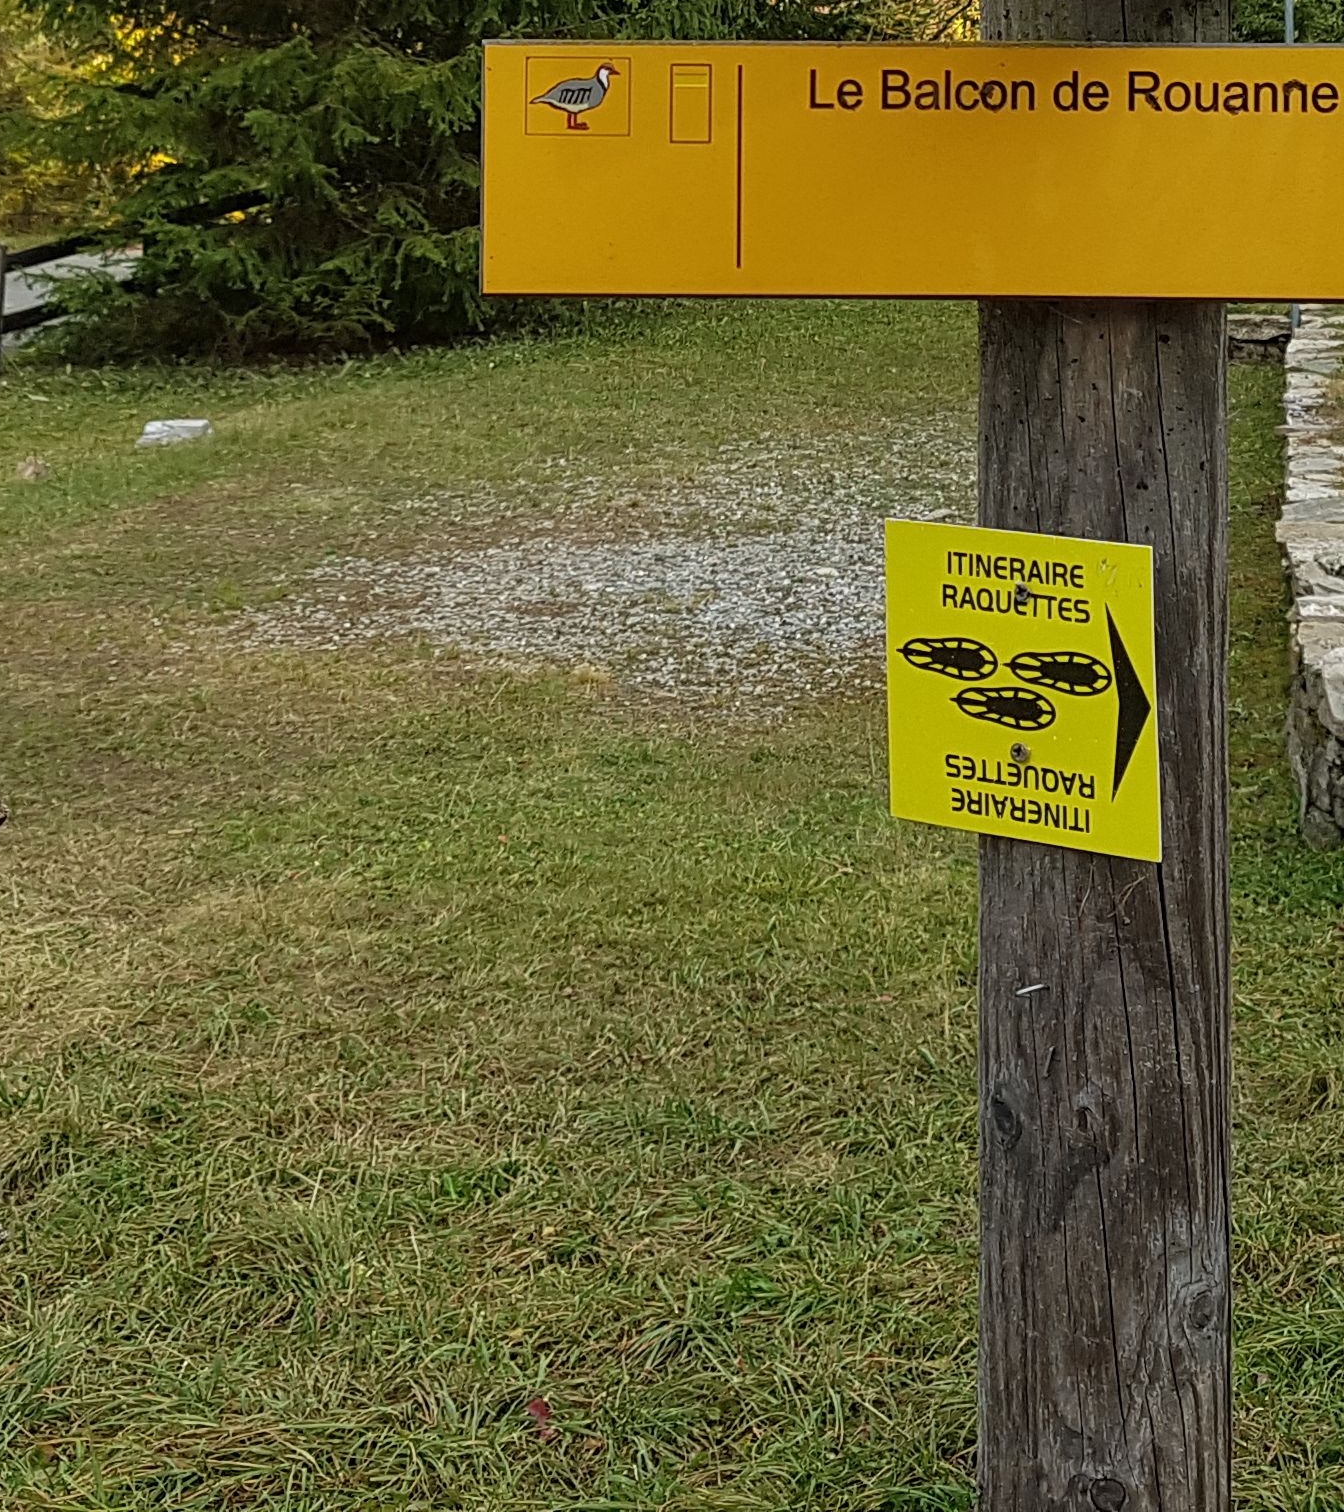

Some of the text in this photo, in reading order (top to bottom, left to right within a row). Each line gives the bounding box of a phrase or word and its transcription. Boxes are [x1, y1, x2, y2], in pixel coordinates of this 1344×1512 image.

[809, 69, 1340, 115] Le Balcon de Rouanne
[947, 551, 1084, 588] ITINERAIRE
[942, 584, 1091, 624] RAQUETTES
[945, 754, 1096, 800] RAQUETTES
[951, 788, 1090, 834] ITINERAIRE
